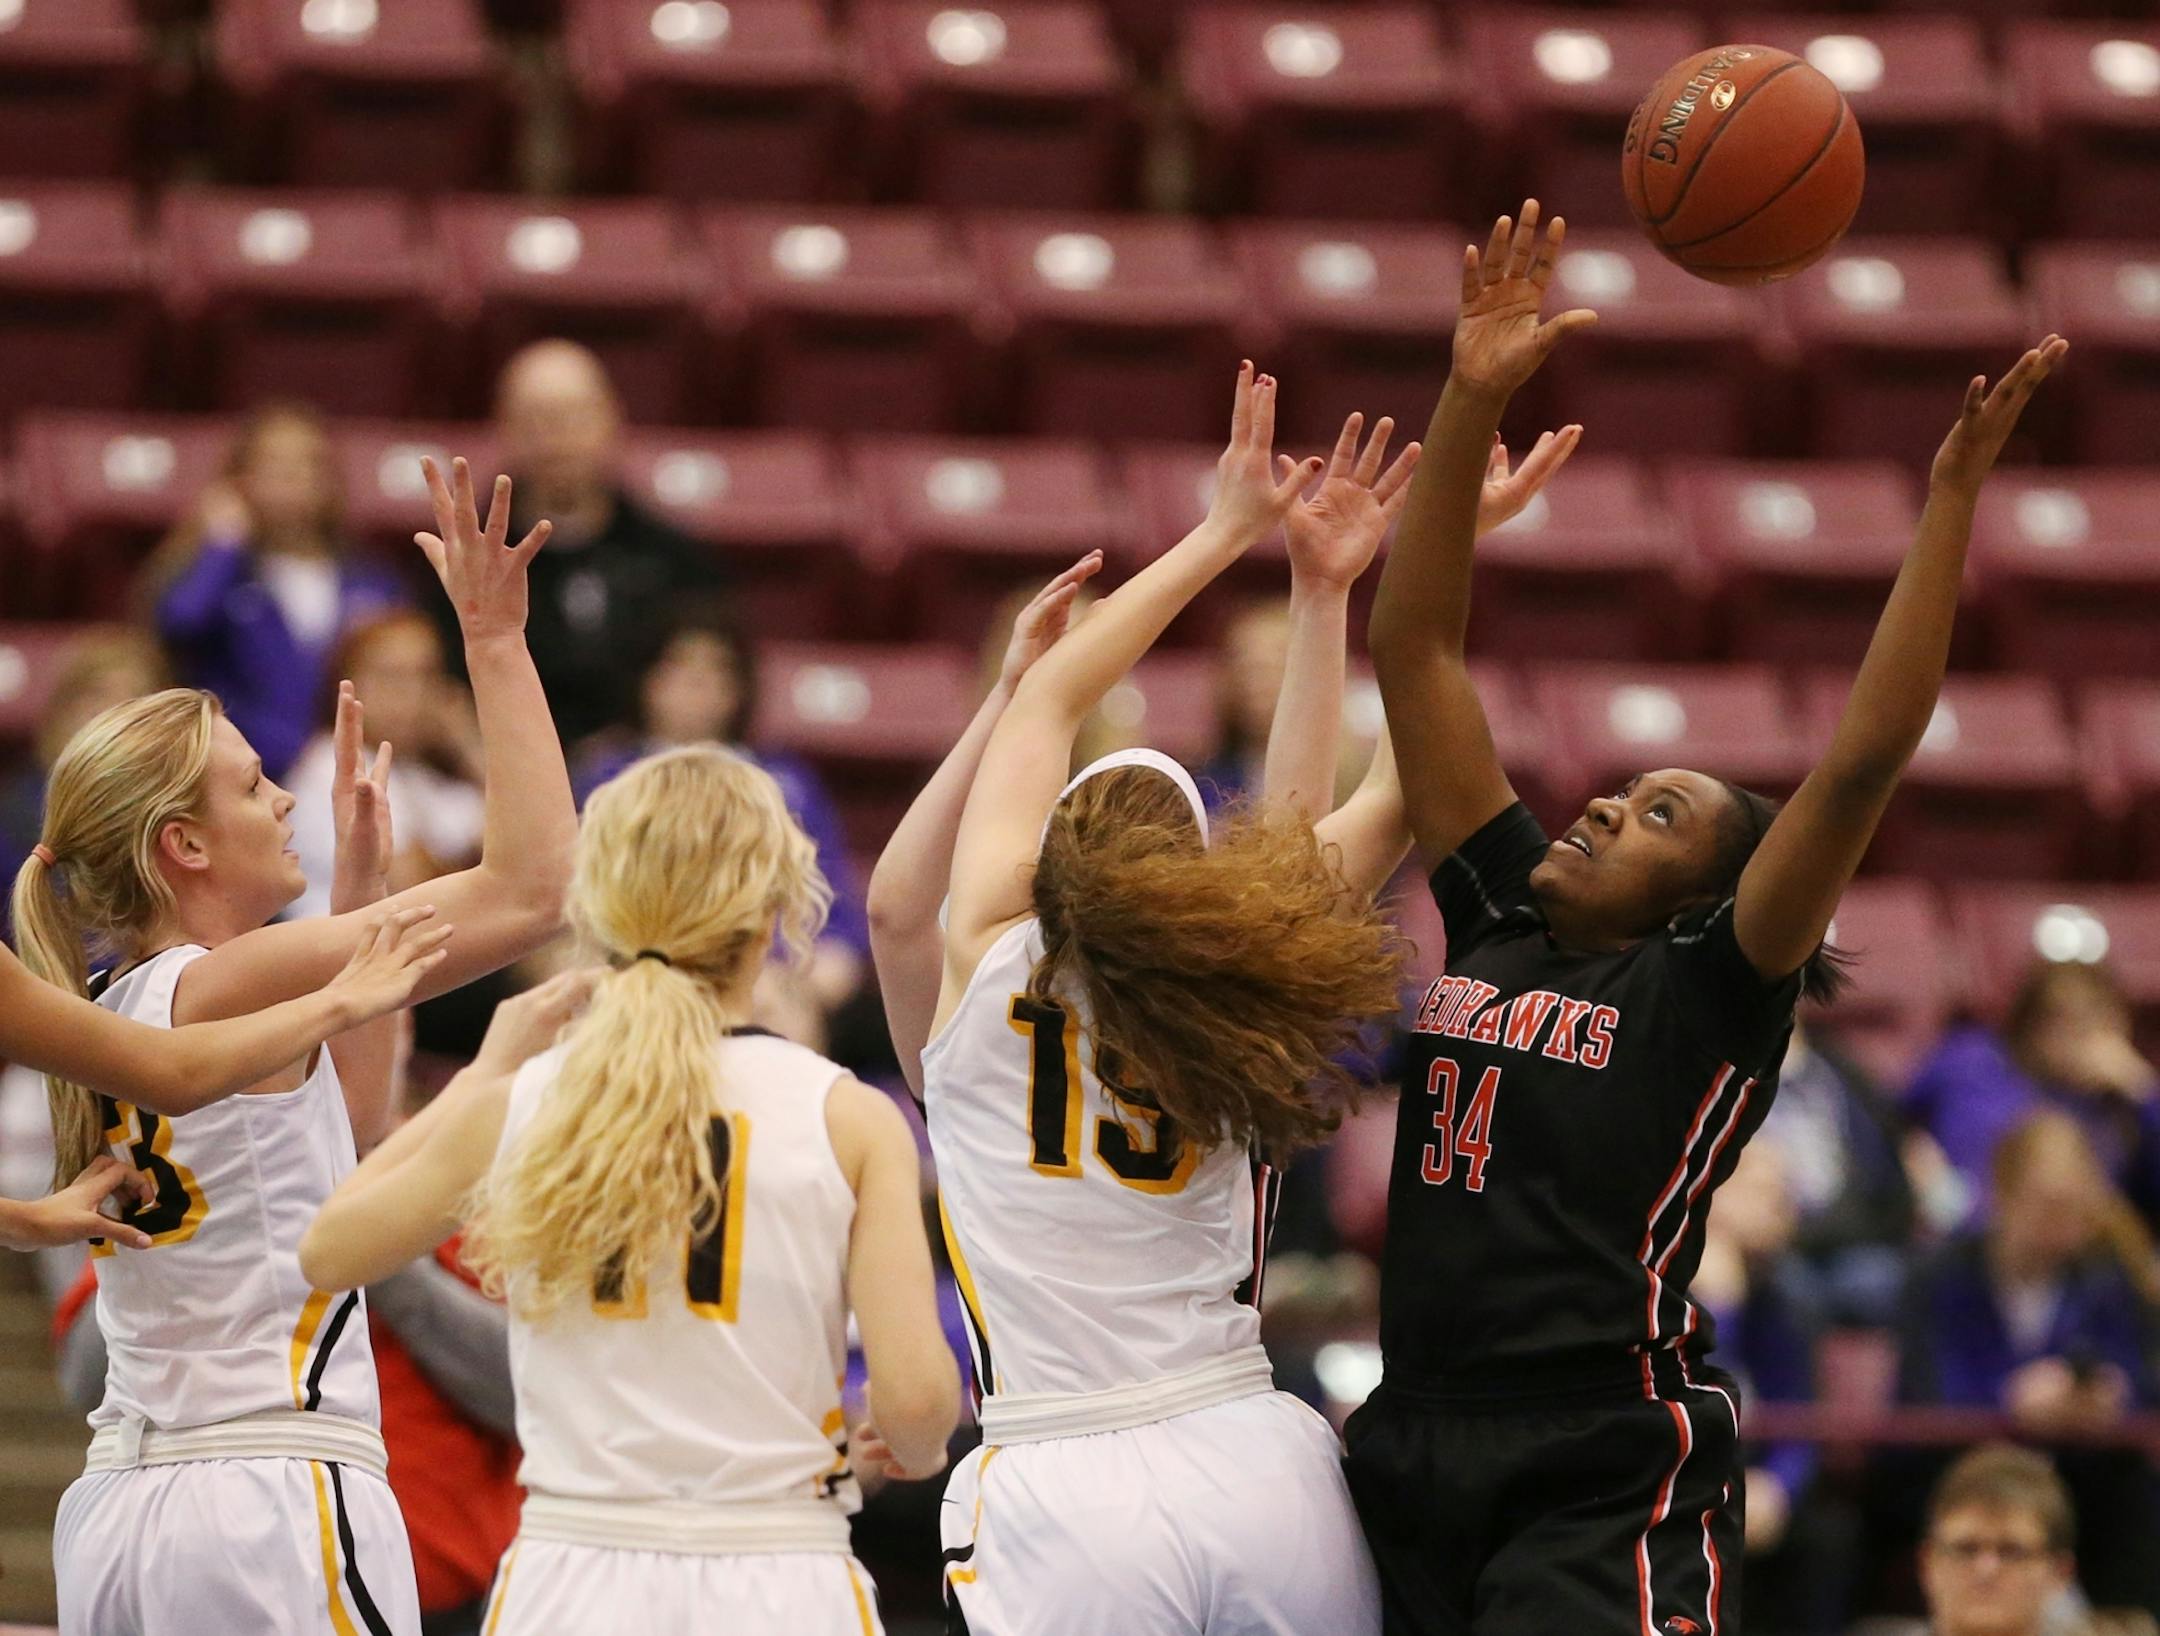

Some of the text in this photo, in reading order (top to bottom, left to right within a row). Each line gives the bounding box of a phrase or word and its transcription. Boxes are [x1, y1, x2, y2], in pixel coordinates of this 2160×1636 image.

[1648, 47, 1764, 166] PALDING
[1420, 1056, 1502, 1193] 34
[591, 1110, 752, 1325] 1
